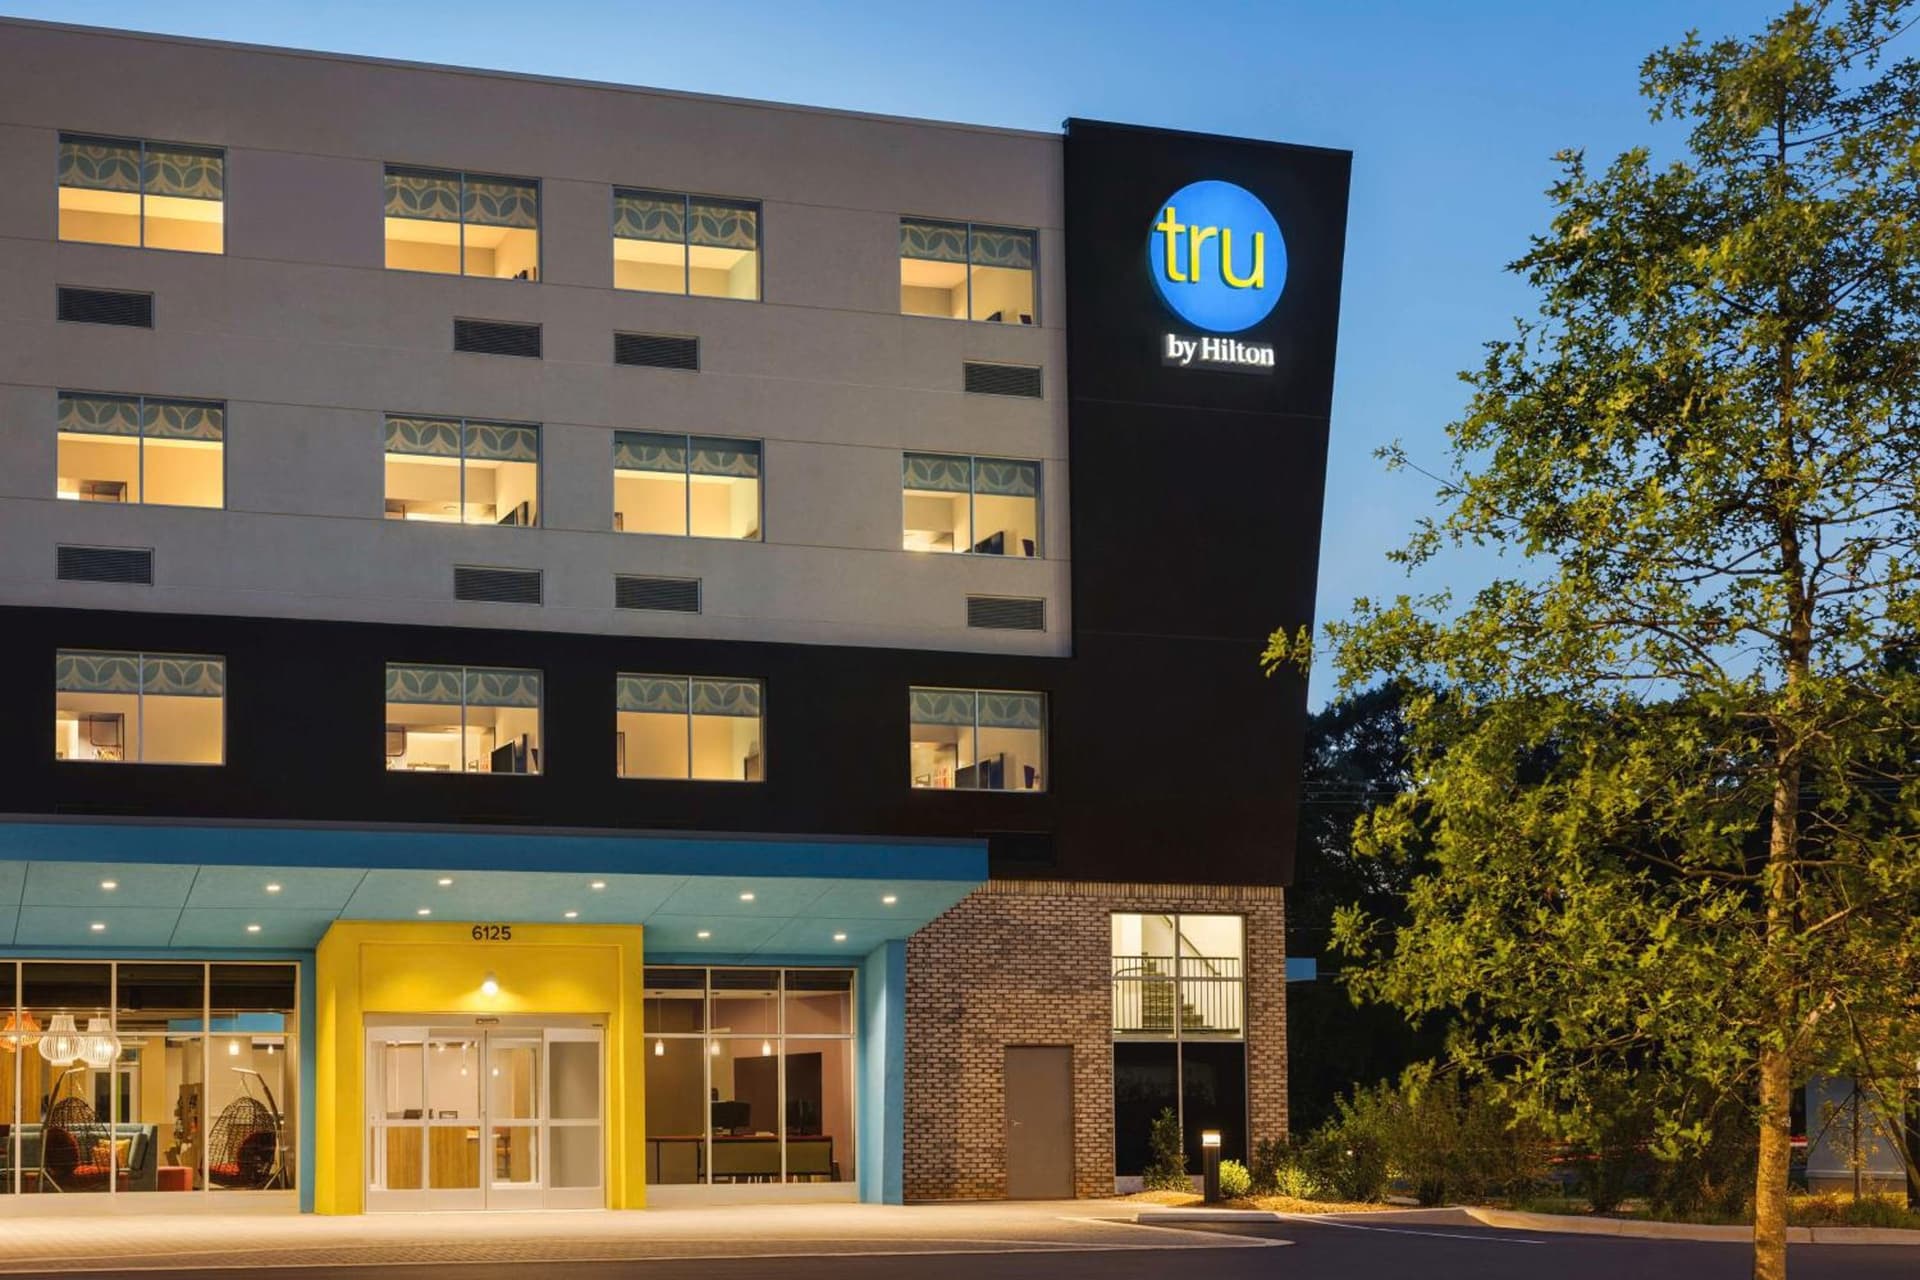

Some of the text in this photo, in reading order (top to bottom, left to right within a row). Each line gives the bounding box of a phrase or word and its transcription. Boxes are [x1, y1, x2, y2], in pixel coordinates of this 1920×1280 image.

[1156, 207, 1265, 289] tru
[1166, 333, 1275, 366] by Hilton
[472, 925, 512, 941] 6125
